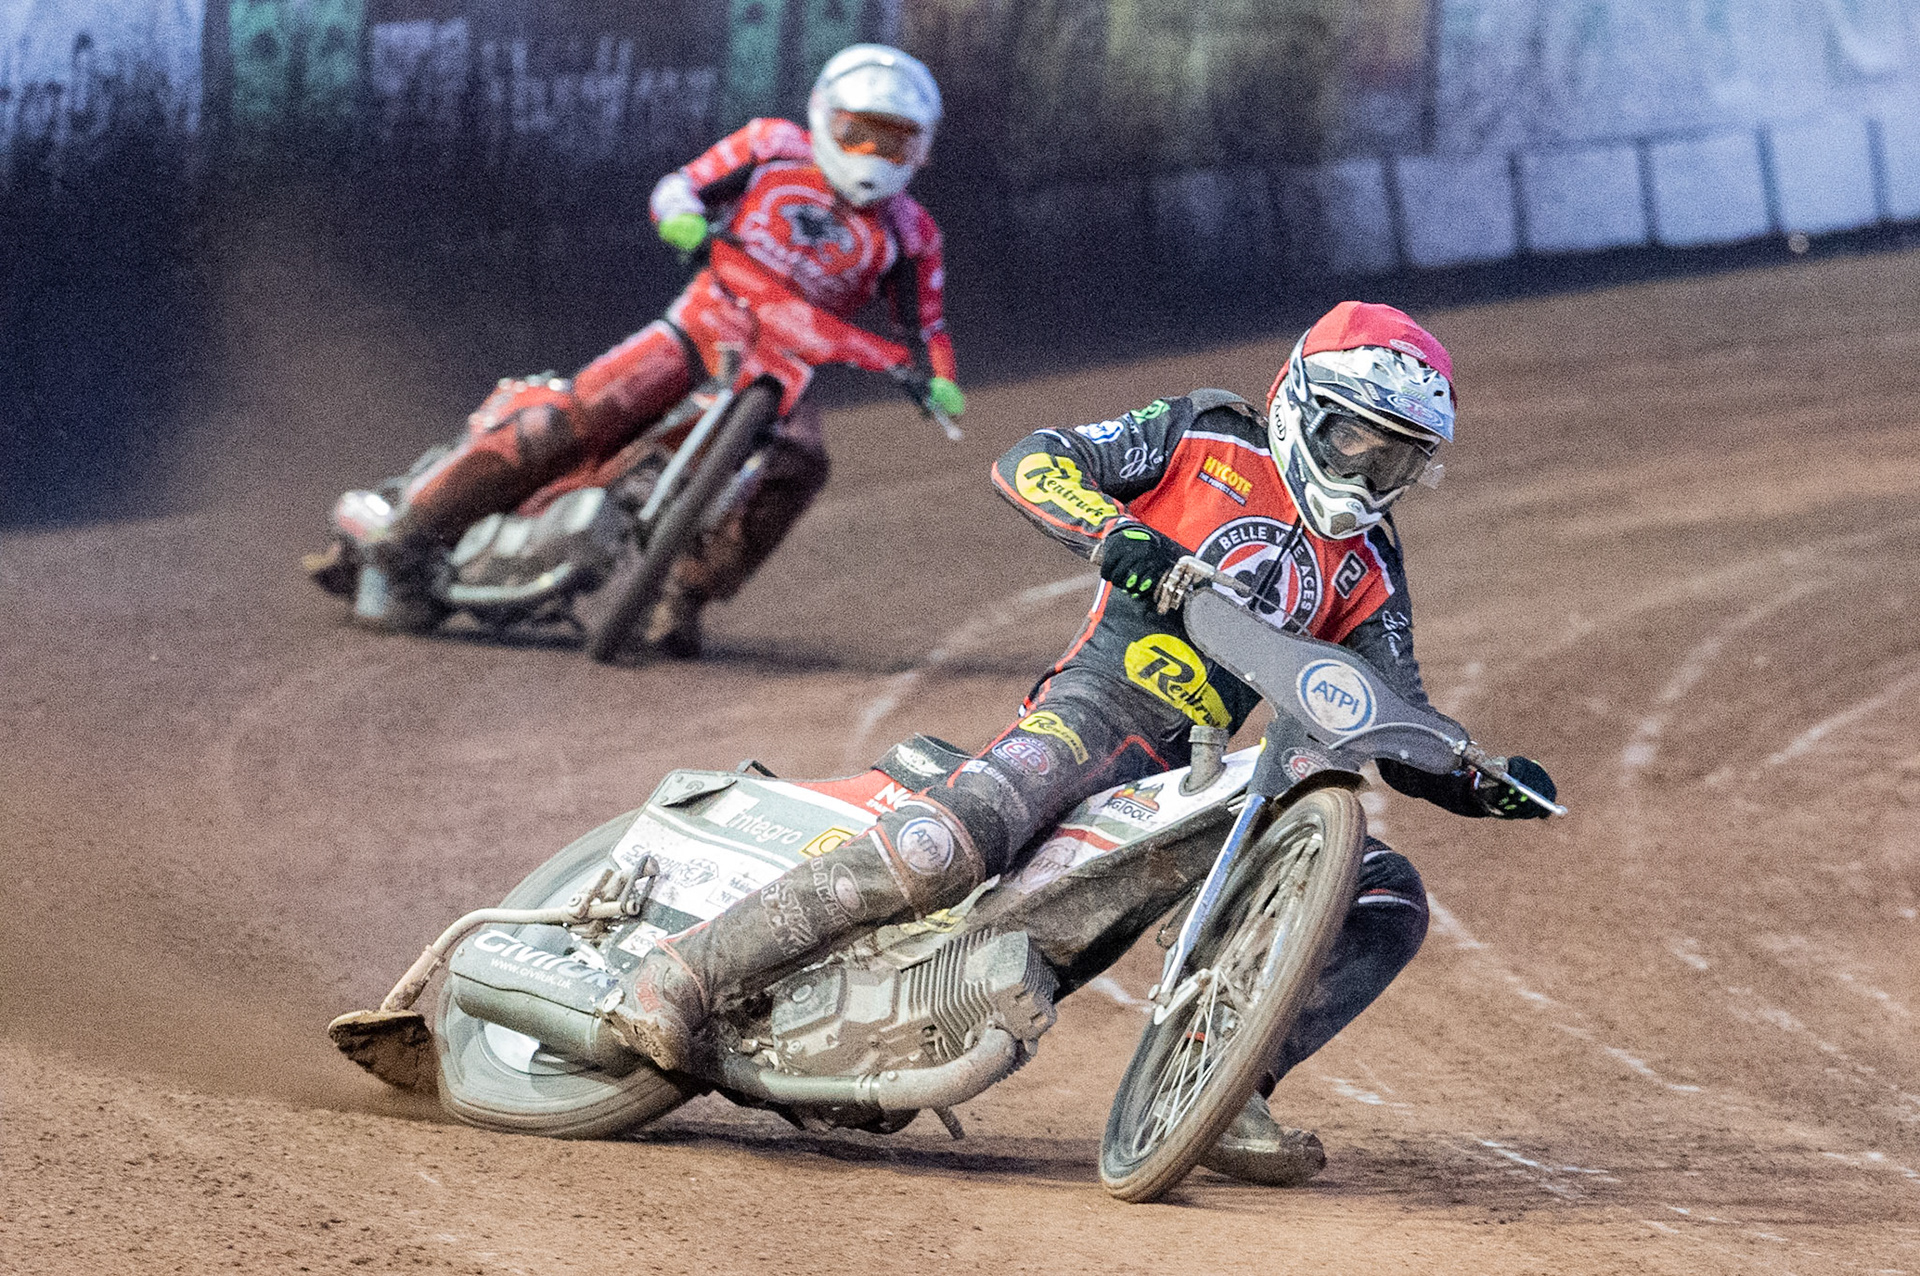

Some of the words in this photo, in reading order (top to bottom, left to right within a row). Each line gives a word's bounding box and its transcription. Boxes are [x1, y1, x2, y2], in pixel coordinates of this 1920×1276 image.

[1203, 456, 1252, 495] HYCOTE
[1219, 526, 1268, 550] BELLE
[1275, 531, 1305, 558] VE
[1300, 565, 1315, 611] ACES
[1138, 645, 1219, 728] Rentru
[1311, 680, 1360, 716] ATPI
[911, 828, 942, 862] ATPI
[810, 857, 853, 930] OAKLE
